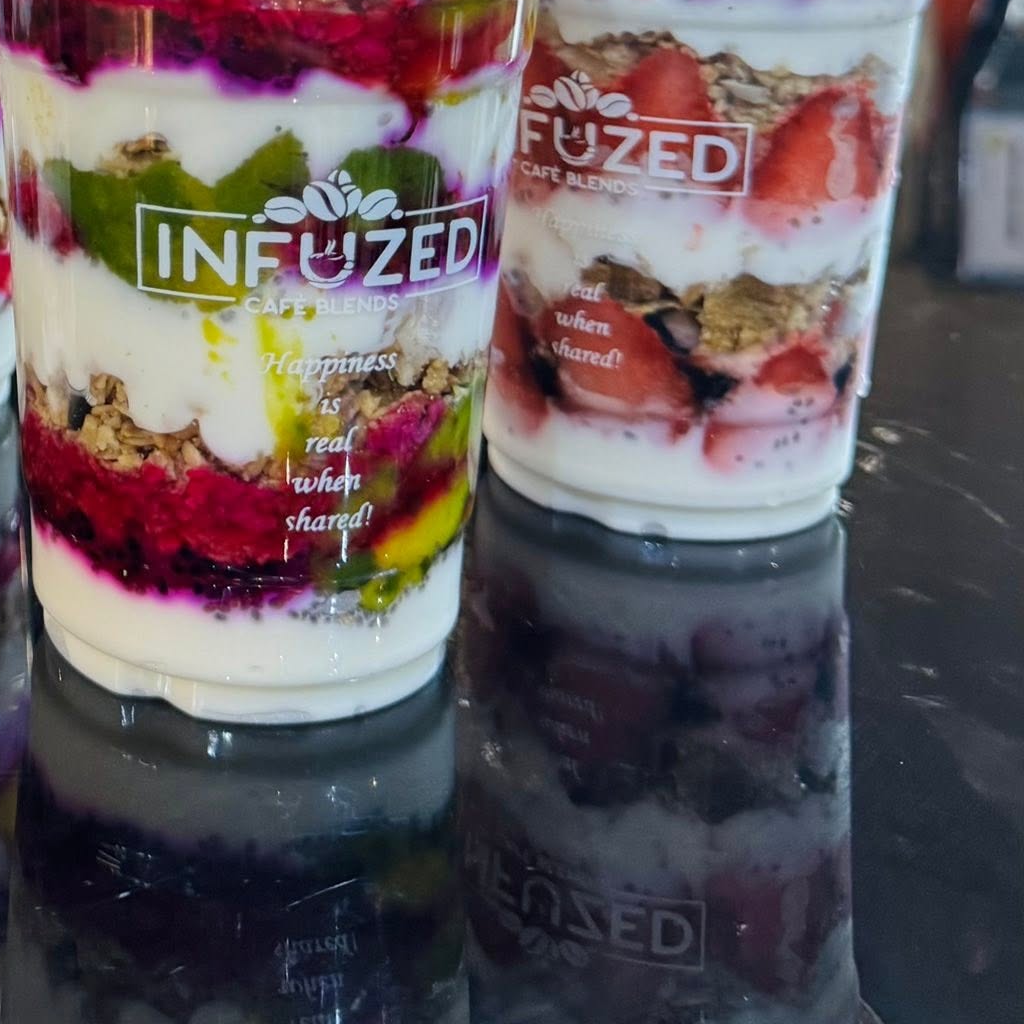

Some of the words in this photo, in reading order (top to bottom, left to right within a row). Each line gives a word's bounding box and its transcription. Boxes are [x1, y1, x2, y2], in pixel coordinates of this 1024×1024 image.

[520, 109, 740, 182] FUZED
[520, 160, 561, 182] CAFÉ
[566, 171, 640, 196] BLENDS
[157, 217, 477, 290] INFUZED
[244, 295, 307, 316] CAFÉ
[315, 293, 400, 314] BLENDS
[554, 309, 611, 336] when
[260, 351, 398, 382] Happiness
[552, 337, 624, 369] shared!
[320, 391, 341, 415] is
[305, 426, 358, 453] real
[291, 467, 361, 494] when
[285, 501, 373, 532] shared!
